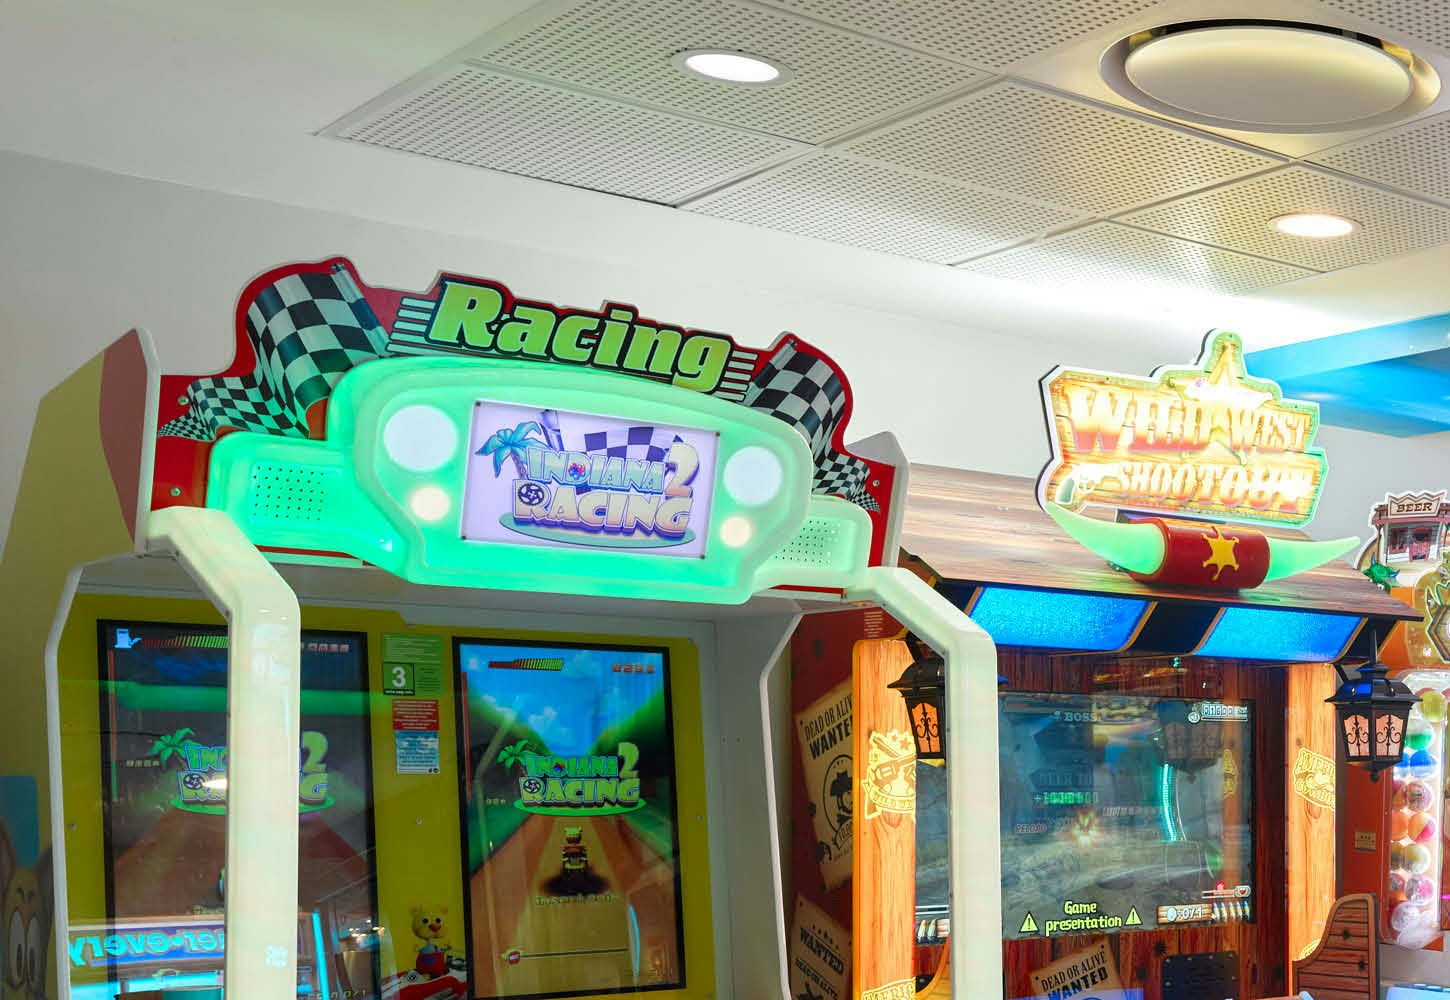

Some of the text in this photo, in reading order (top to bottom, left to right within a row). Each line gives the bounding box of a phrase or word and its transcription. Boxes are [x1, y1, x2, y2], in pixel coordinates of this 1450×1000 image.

[427, 280, 732, 393] Racing
[1227, 405, 1313, 452] WEST
[526, 441, 700, 499] INDIANA 2
[511, 480, 695, 539] RACING
[1396, 502, 1433, 513] BEER
[391, 666, 407, 688] 3
[804, 715, 825, 741] DEAD
[825, 707, 835, 727] OR
[809, 714, 853, 760] WANTE
[302, 730, 328, 773] 2
[525, 742, 640, 779] INDIANA 2
[518, 776, 641, 808] RACING
[1045, 914, 1122, 937] presentation
[1064, 900, 1097, 915] Game
[800, 927, 845, 976] WANTED
[1041, 951, 1106, 993] DEAD OR ALIVE
